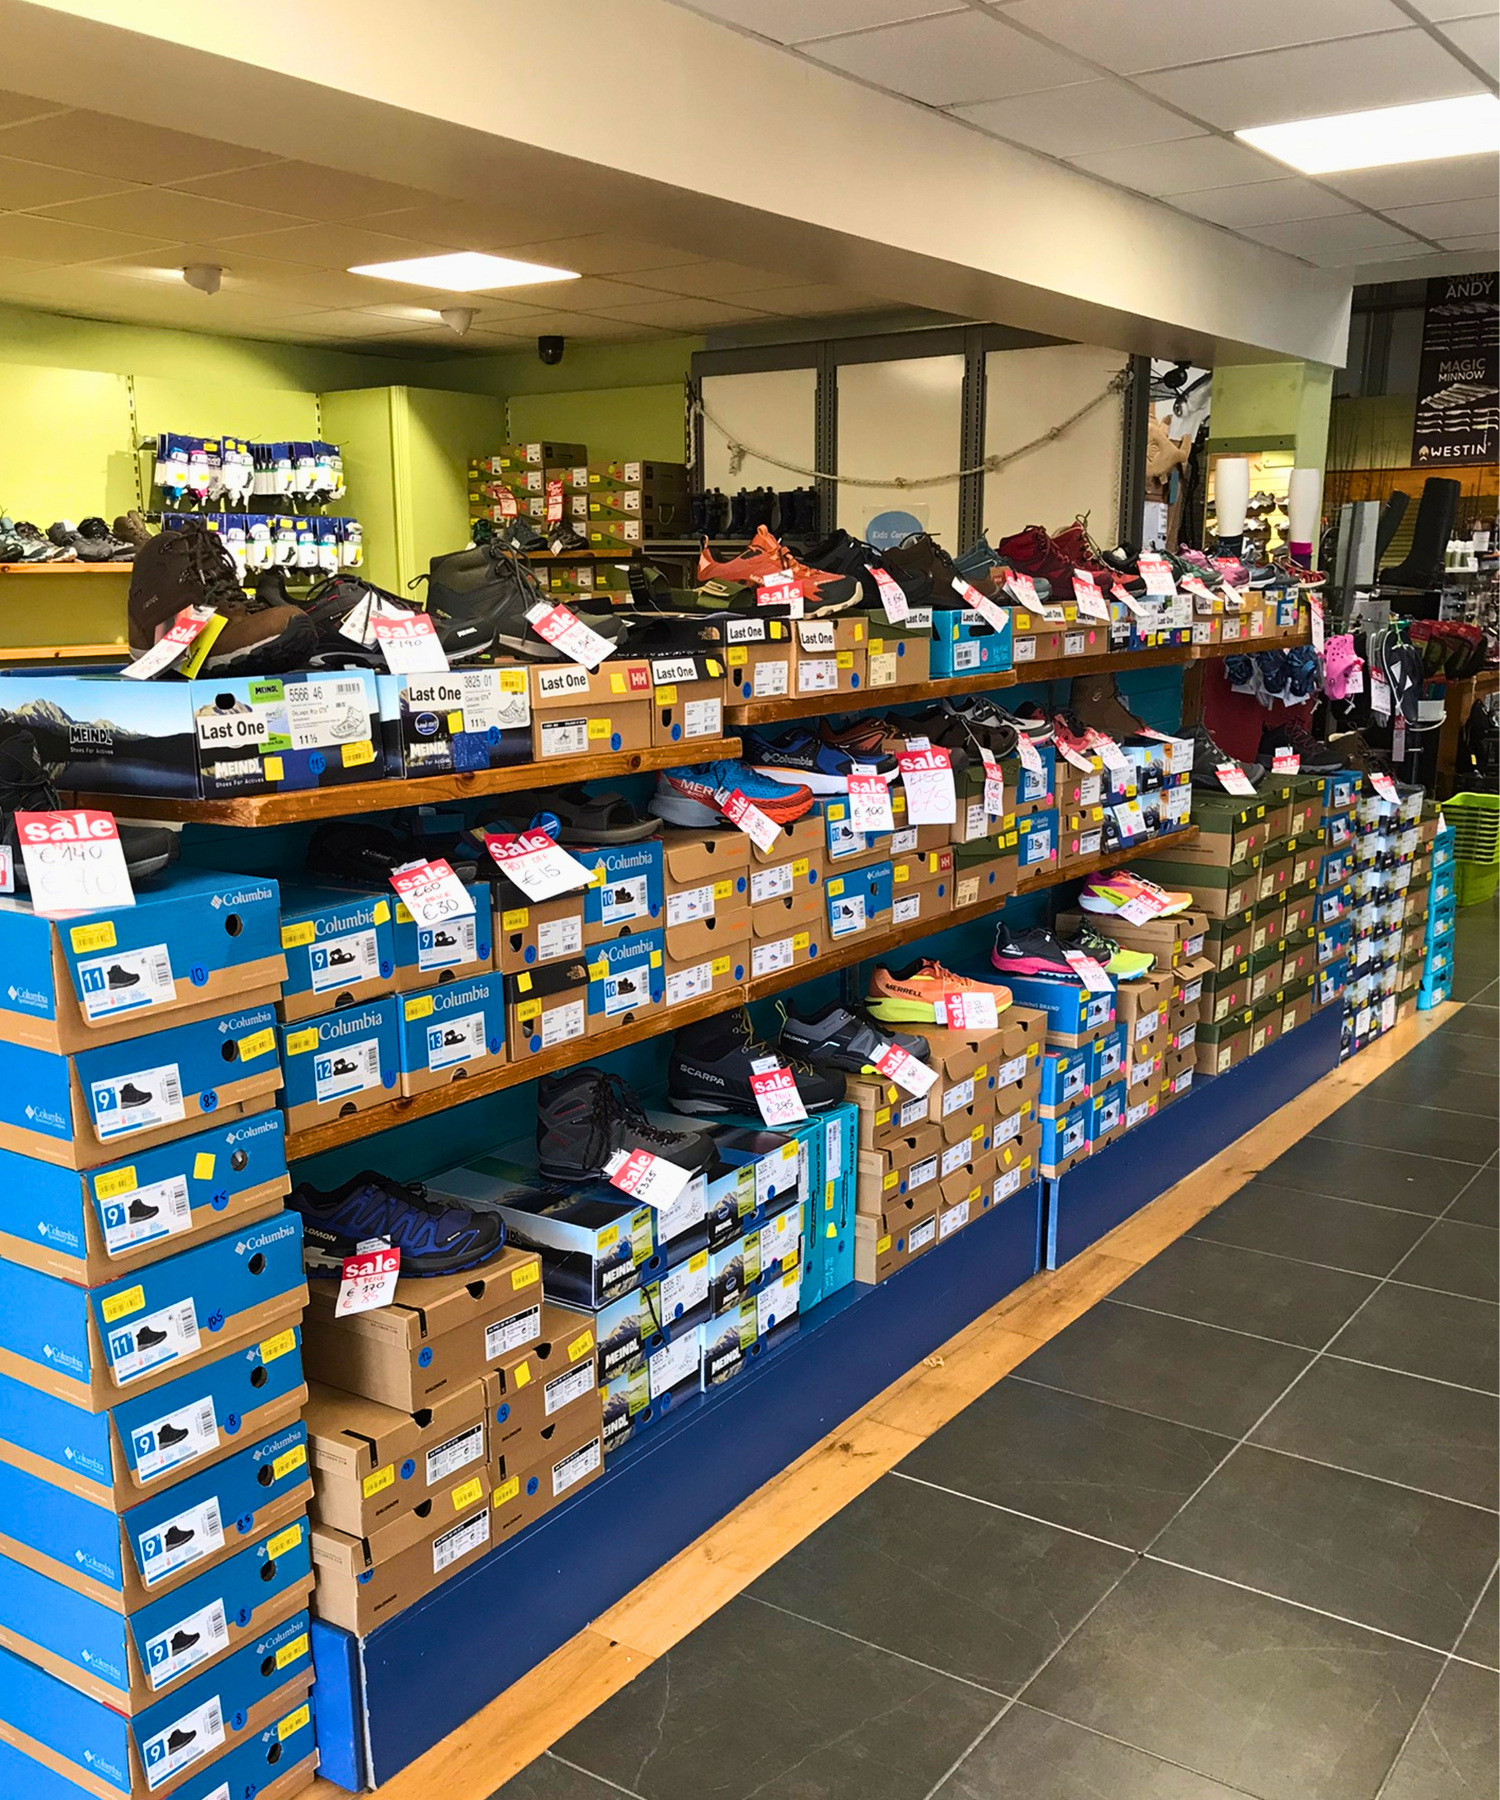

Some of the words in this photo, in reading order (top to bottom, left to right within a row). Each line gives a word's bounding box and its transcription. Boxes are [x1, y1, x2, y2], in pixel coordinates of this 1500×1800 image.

[1446, 280, 1494, 298] ANDY
[1440, 358, 1486, 373] MAGIC
[1438, 370, 1485, 382] MINNOW
[1431, 445, 1487, 457] WESTIN
[872, 530, 888, 539] Kids
[1140, 562, 1170, 573] sale
[759, 585, 800, 603] sale
[1074, 583, 1101, 595] sale
[541, 611, 576, 640] sale
[918, 614, 929, 622] One
[168, 623, 197, 642] sale
[376, 620, 429, 639] sale
[730, 628, 747, 638] Last
[749, 627, 762, 637] One
[801, 633, 817, 644] Last
[819, 632, 833, 643] One
[631, 672, 647, 686] HH
[656, 669, 674, 680] Last
[677, 667, 694, 677] One
[541, 678, 563, 691] Last
[567, 676, 587, 687] One
[289, 688, 309, 702] 5566
[313, 686, 323, 700] 46
[409, 687, 434, 702] Last
[438, 686, 461, 700] One
[69, 726, 113, 745] MEINDL
[201, 725, 233, 740] Last
[237, 721, 265, 736] One
[410, 741, 450, 760] MEINDL
[215, 757, 263, 779] MEINDL
[771, 753, 814, 767] Columbia
[901, 755, 948, 770] sale
[1273, 757, 1298, 768] sale
[986, 767, 1002, 781] sale
[1219, 770, 1244, 782] sale
[216, 780, 232, 788] Shoes
[849, 778, 886, 793] sale
[728, 796, 749, 823] sale
[24, 812, 114, 842] sale
[489, 835, 549, 860] sale
[606, 852, 652, 872] Columbia
[396, 865, 451, 891] sale
[223, 887, 272, 907] Columbia
[603, 891, 614, 906] 10
[1137, 892, 1162, 912] sale
[422, 899, 460, 921] €30
[314, 909, 375, 937] Columbia
[422, 934, 430, 948] 9
[608, 938, 654, 962] Columbia
[315, 952, 324, 968] 9
[84, 970, 102, 992] 11
[606, 983, 617, 996] 10
[17, 987, 48, 1003] Columbia
[433, 985, 490, 1011] Columbia
[885, 982, 923, 998] MERRELL
[953, 994, 965, 1028] sale
[1039, 1004, 1060, 1012] BRAND
[229, 1012, 272, 1031] Columbia
[319, 1011, 382, 1040] Columbia
[430, 1032, 442, 1048] 13
[317, 1064, 331, 1079] 12
[881, 1050, 910, 1077] sale
[680, 1063, 726, 1087] SCARPA
[754, 1074, 792, 1094] sale
[34, 1107, 66, 1126] Columbia
[235, 1120, 278, 1141] Columbia
[620, 1154, 651, 1191] sale
[246, 1225, 295, 1250] Columbia
[303, 1226, 337, 1242] LOMON
[346, 1254, 397, 1278] sale
[602, 1258, 636, 1287] MEINDL
[363, 1275, 385, 1284] PRICE
[419, 1351, 432, 1364] 12
[605, 1338, 639, 1369] MEINDL
[711, 1347, 741, 1375] MEINDL
[425, 1379, 447, 1394] SALOMON
[229, 1414, 236, 1427] 8
[603, 1413, 628, 1436] EINDL
[502, 1427, 522, 1442] SALOMON
[139, 1437, 150, 1454] 9
[262, 1431, 302, 1456] Columbia
[376, 1499, 400, 1516] SALOMON
[503, 1514, 522, 1529] SALOMON
[374, 1594, 397, 1612] SALOMON
[239, 1609, 247, 1623] 8
[265, 1620, 304, 1649] Columbia
[153, 1646, 163, 1663] 9
[236, 1712, 243, 1725] 8
[151, 1744, 161, 1761] 9
